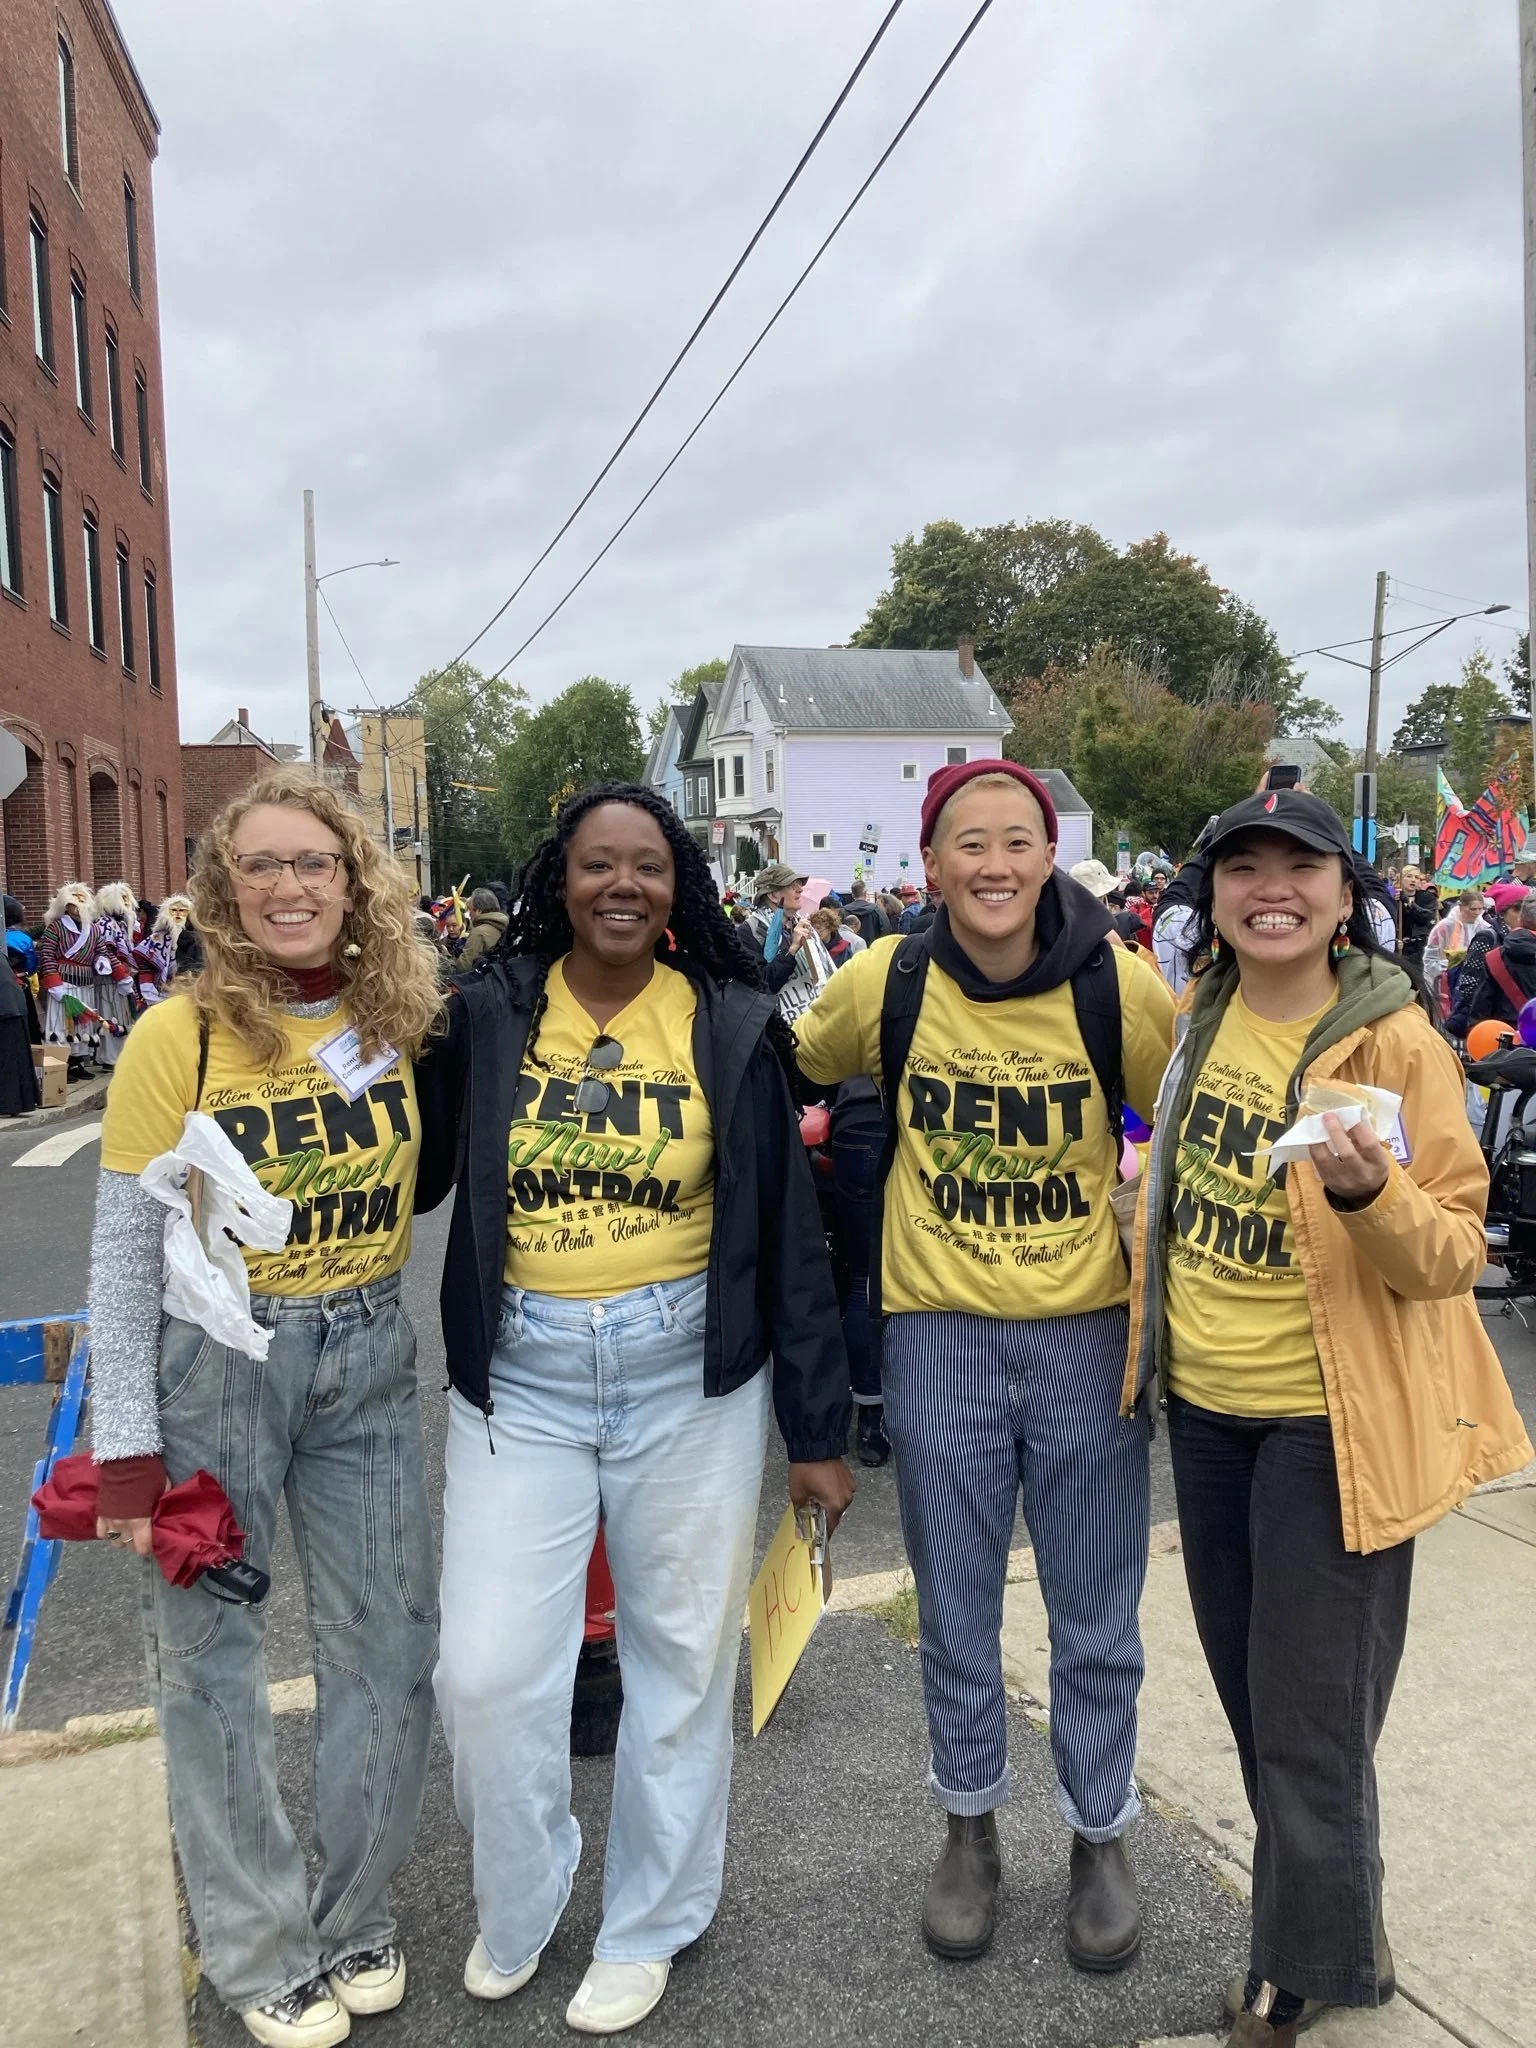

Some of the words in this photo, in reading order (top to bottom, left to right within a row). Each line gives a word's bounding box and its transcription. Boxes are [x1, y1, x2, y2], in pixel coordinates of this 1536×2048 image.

[777, 986, 807, 1010] ILL
[342, 1056, 356, 1070] Rent
[617, 1060, 644, 1071] enda
[945, 1047, 998, 1064] Controla
[1001, 1050, 1044, 1066] Renda
[214, 1080, 411, 1165] RENT
[511, 1073, 692, 1140] RENT
[908, 1073, 1092, 1147] RENT
[249, 1131, 402, 1207] Now!
[508, 1119, 672, 1179] Now!
[924, 1130, 1073, 1187] Now!
[1182, 1091, 1287, 1191] ENT
[286, 1182, 402, 1246] NTROL
[534, 1233, 548, 1253] de
[552, 1223, 595, 1253] Renta
[561, 1201, 621, 1223] 租金管制
[910, 1214, 954, 1244] Control
[972, 1229, 1027, 1243] 租金管制
[1172, 1186, 1292, 1268] NTROL
[764, 1545, 803, 1664] HC
